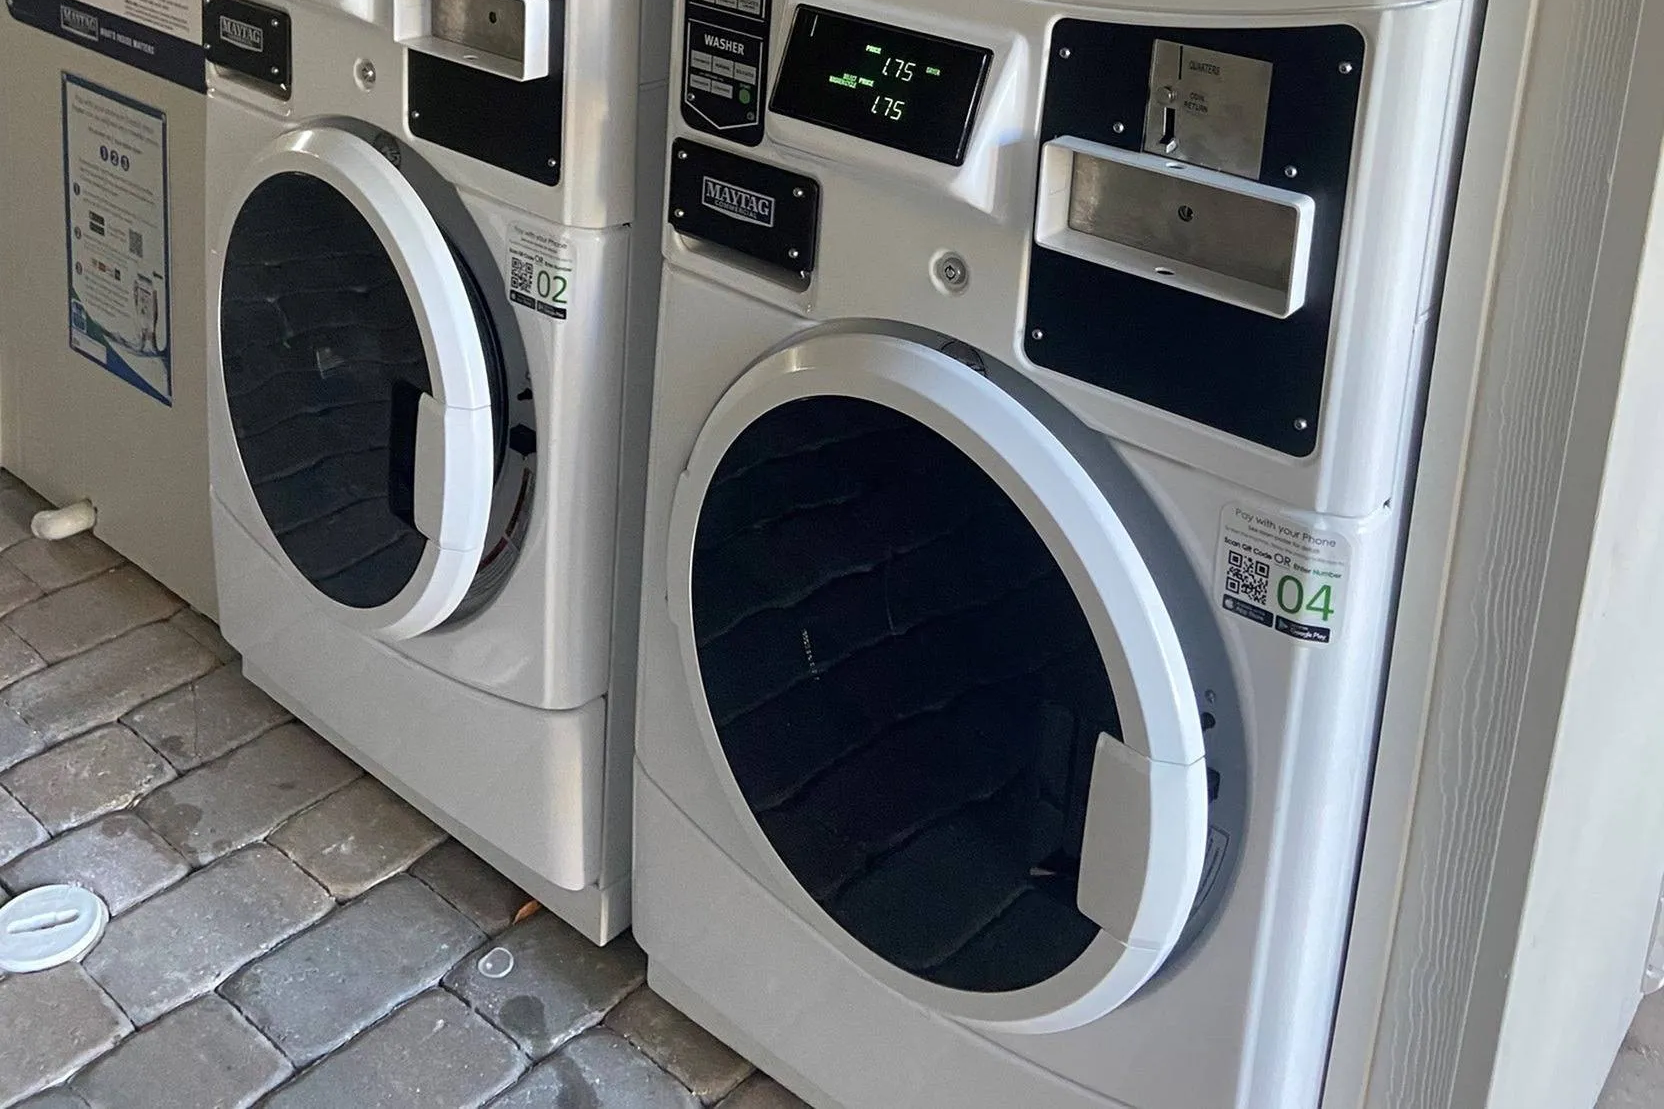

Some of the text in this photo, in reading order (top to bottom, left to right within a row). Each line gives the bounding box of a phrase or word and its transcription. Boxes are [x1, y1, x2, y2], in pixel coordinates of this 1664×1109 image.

[222, 18, 261, 44] MAYTAG
[703, 33, 745, 56] WASHER
[881, 57, 917, 82] 1.75
[1188, 60, 1221, 76] QUARTERS
[870, 95, 905, 121] 1.75
[1183, 100, 1209, 113] RETURN
[705, 181, 770, 216] MAYTAG
[537, 270, 567, 304] 02
[1235, 508, 1337, 548] Pay with your Phone
[1224, 536, 1241, 548] Scan
[1242, 543, 1253, 552] QR
[1253, 547, 1272, 560] Code
[1273, 553, 1292, 567] OR
[1312, 569, 1342, 579] Number
[1277, 575, 1334, 621] 04
